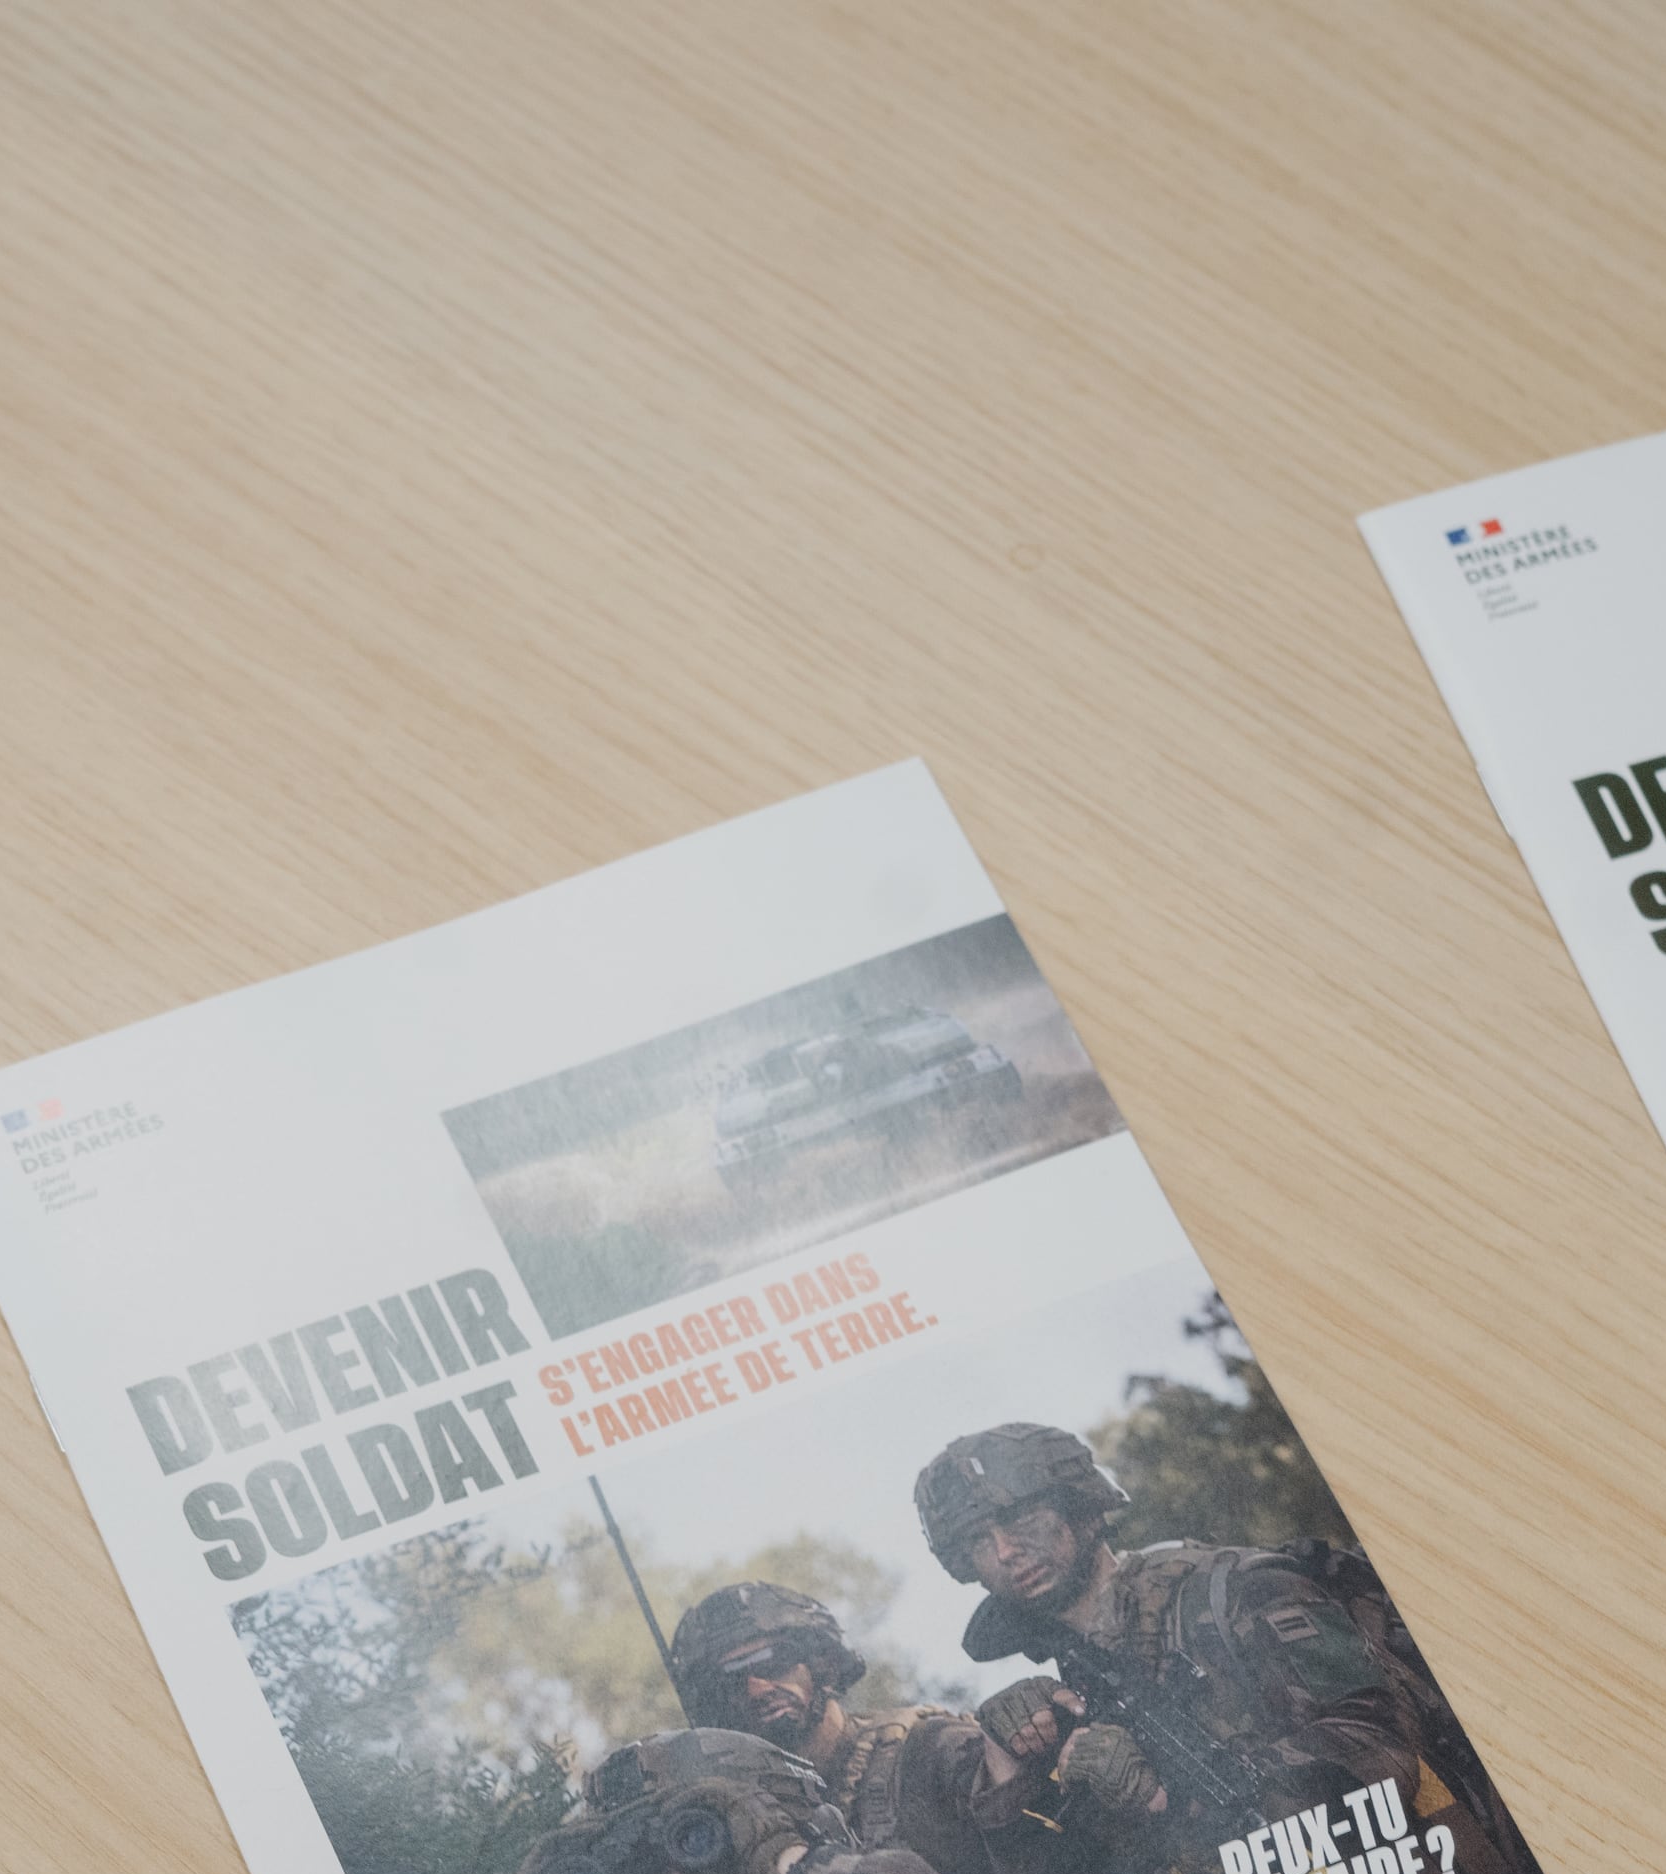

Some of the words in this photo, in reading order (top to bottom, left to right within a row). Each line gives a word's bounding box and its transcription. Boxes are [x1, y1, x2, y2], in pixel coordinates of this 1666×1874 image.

[20, 1147, 67, 1175] DES
[125, 1267, 531, 1477] DEVENIR
[538, 1295, 768, 1407] S'ENGAGER
[762, 1251, 881, 1325] DANS
[559, 1361, 738, 1458] L'ARMÉE
[733, 1340, 797, 1395] DE
[789, 1290, 940, 1372] TERRE.
[182, 1381, 539, 1583] SOLDAT
